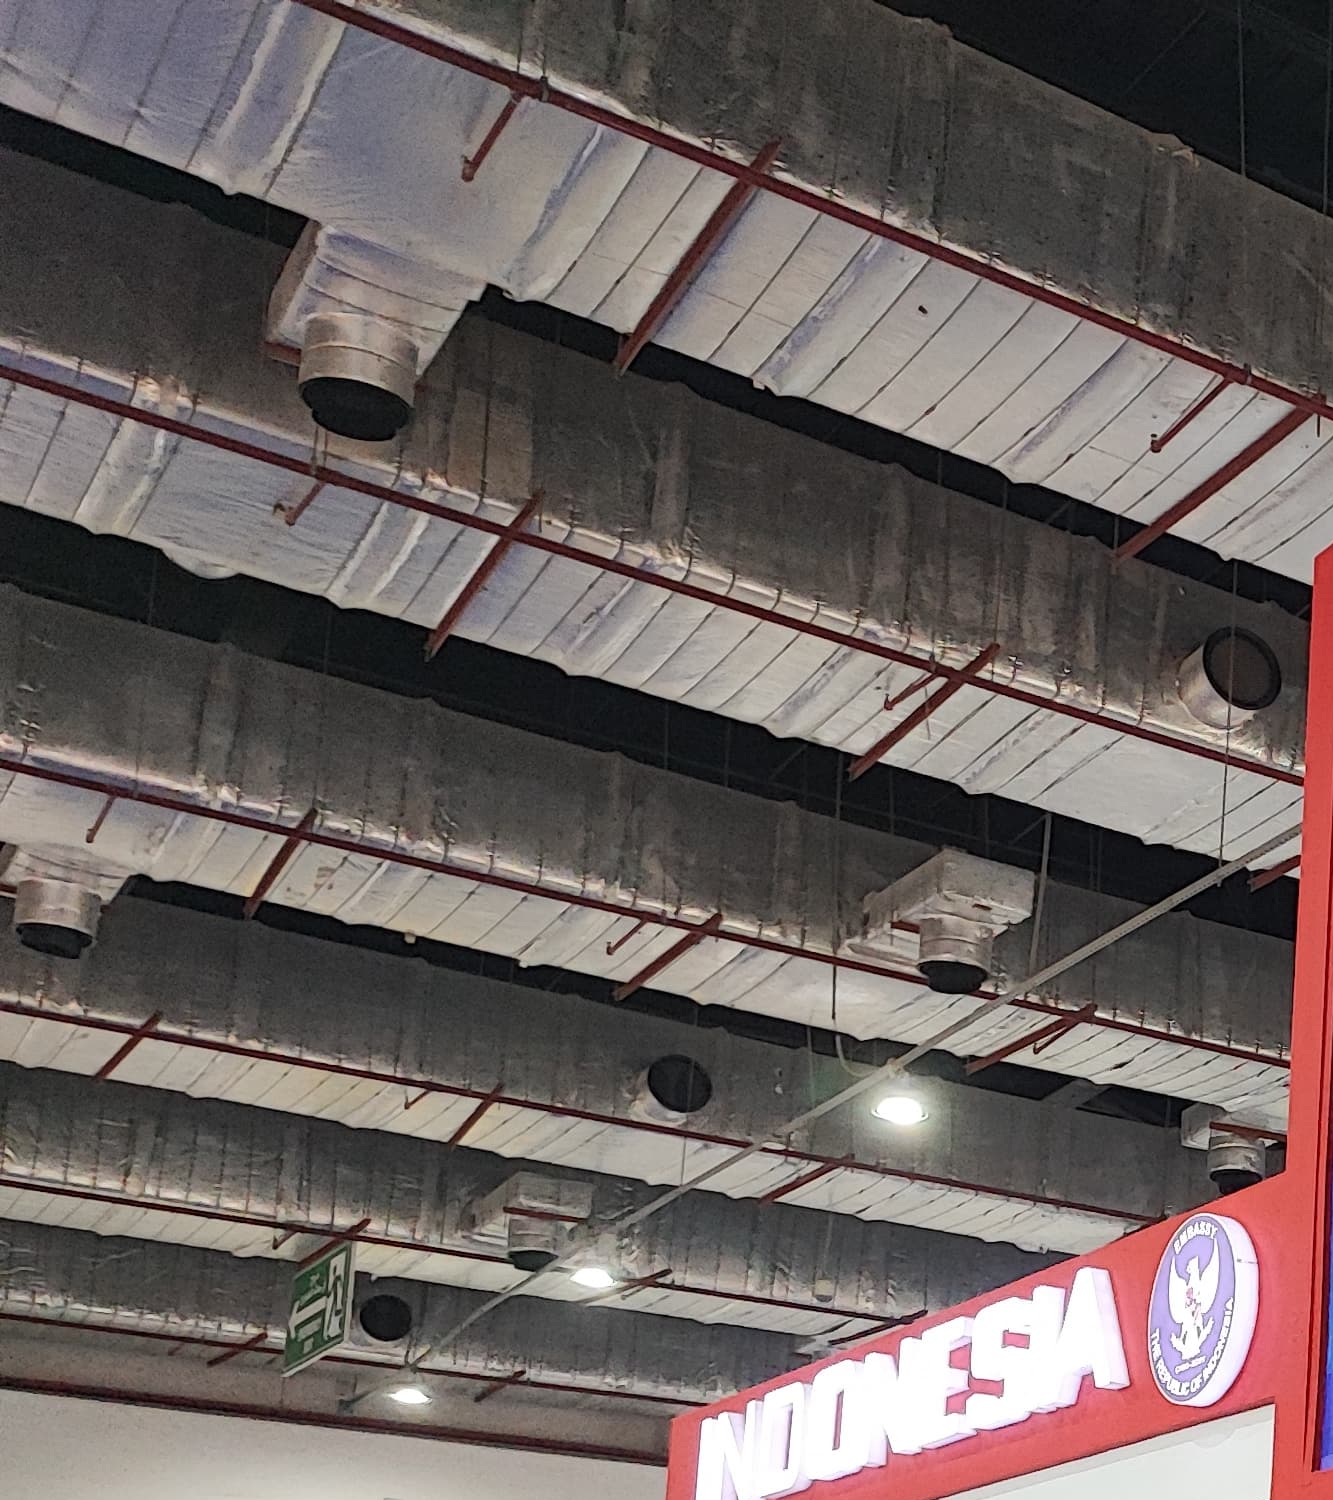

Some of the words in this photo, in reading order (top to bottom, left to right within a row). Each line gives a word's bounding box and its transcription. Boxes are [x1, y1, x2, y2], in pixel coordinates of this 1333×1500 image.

[1173, 1221, 1218, 1255] EMBASSY
[1155, 1357, 1191, 1397] REPUBLIC
[1202, 1297, 1235, 1383] INDONESIA
